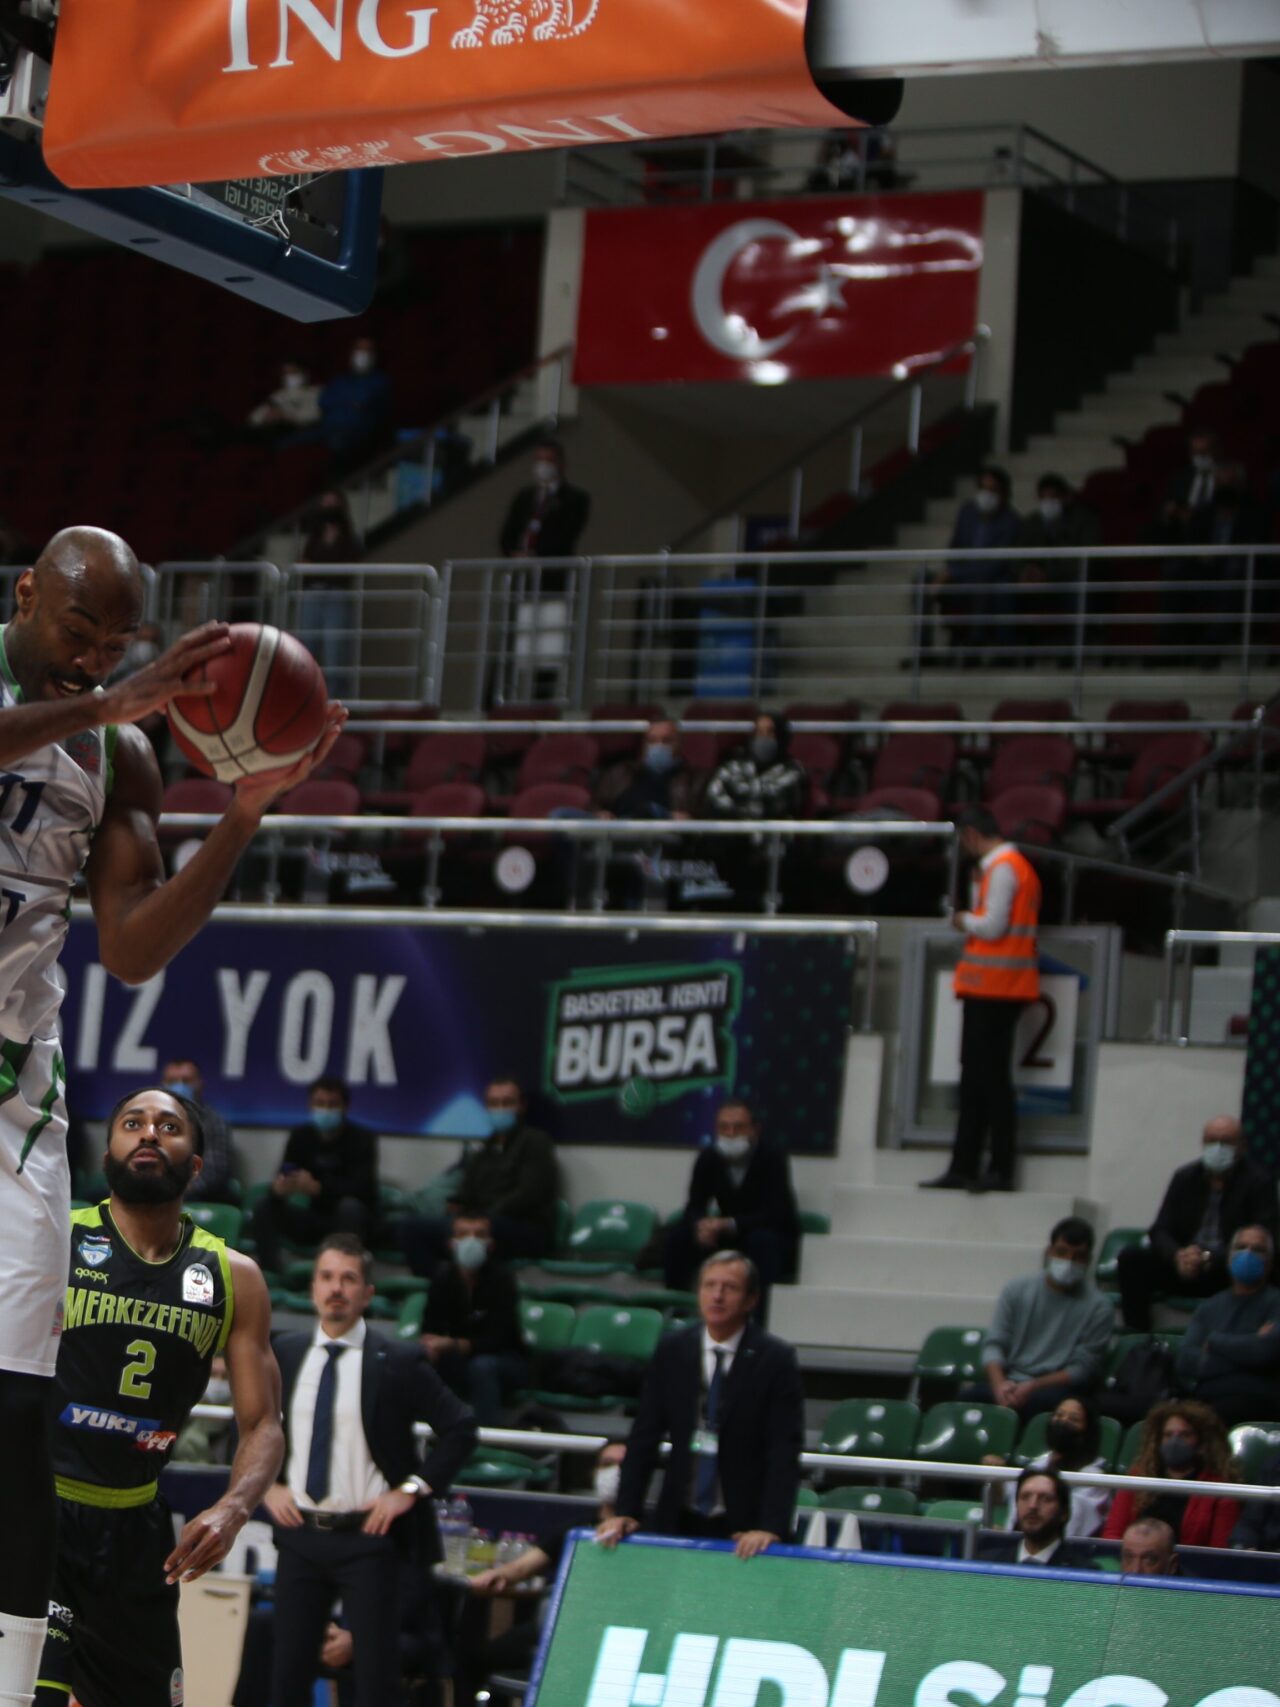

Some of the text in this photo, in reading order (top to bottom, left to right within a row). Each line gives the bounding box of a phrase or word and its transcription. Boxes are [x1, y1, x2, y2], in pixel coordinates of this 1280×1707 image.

[222, 0, 439, 73] ING
[217, 967, 408, 1086] YOK
[561, 986, 667, 1022] BASKETBOL
[553, 1012, 719, 1087] BURSA
[118, 1338, 157, 1400] 2
